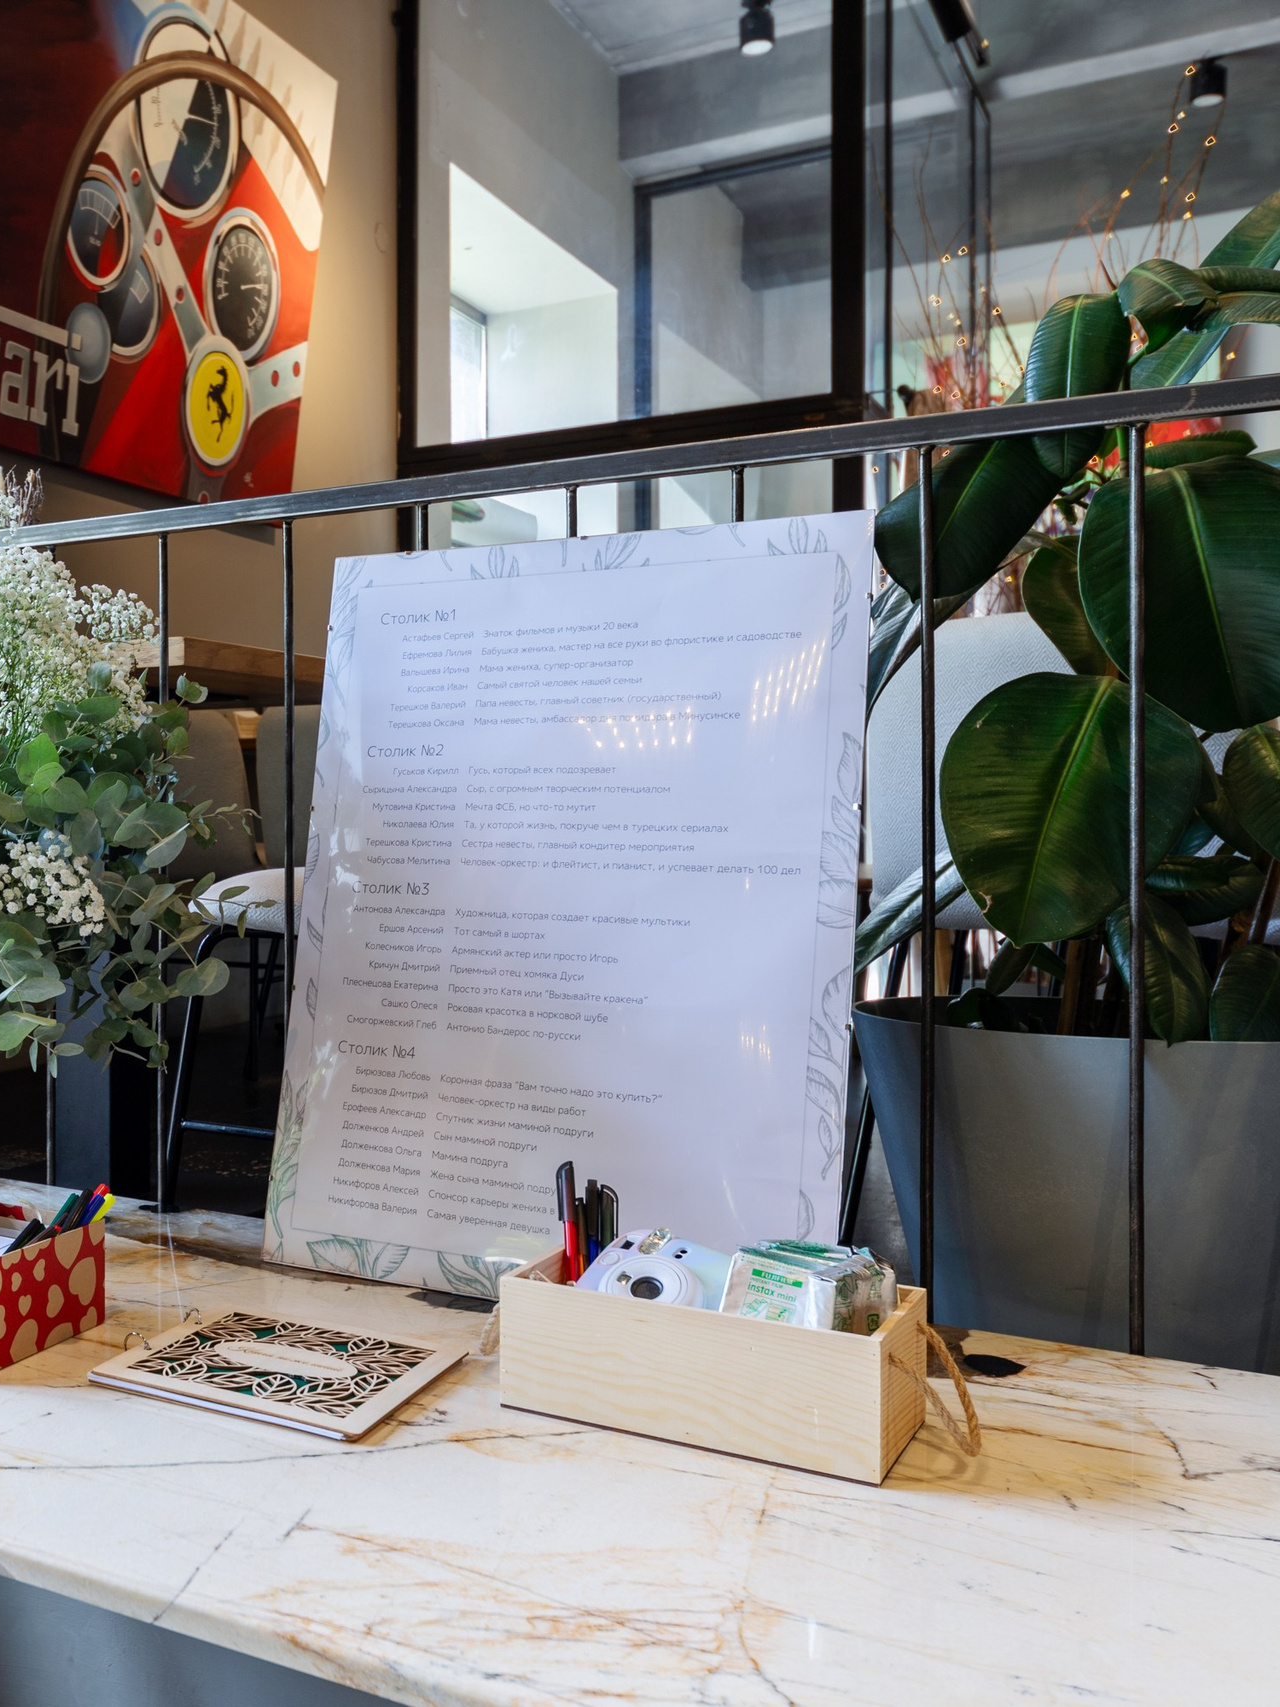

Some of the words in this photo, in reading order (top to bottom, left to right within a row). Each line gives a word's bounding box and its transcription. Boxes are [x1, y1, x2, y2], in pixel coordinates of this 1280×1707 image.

[381, 613, 430, 625] Столик
[435, 609, 455, 622] №1
[402, 634, 441, 642] Астафьев
[443, 631, 474, 641] Сергей
[402, 651, 443, 660] Ефремова
[444, 649, 472, 657] Лилия
[481, 647, 518, 656] Бабушка
[559, 643, 591, 651] мастер
[626, 640, 648, 649] руки
[664, 636, 724, 647] флористике
[736, 631, 802, 641] садоводстве
[401, 668, 441, 677] Валышева
[443, 666, 469, 675] Ирина
[407, 685, 445, 694] Корсаков
[447, 683, 468, 691] Иван
[391, 704, 429, 712] Терешков
[431, 701, 466, 710] Валерий
[389, 721, 431, 729] Терешкова
[433, 719, 464, 727] Оксана
[367, 746, 416, 757] Столик
[421, 744, 444, 756] №2
[393, 768, 425, 777] Гуськов
[427, 767, 459, 776] Кирилл
[362, 786, 404, 794] Сырицына
[407, 785, 457, 794] Александра
[467, 784, 486, 794] Сыр,
[496, 786, 543, 794] огромным
[372, 803, 413, 812] Мутовина
[415, 803, 455, 812] Кристина
[430, 820, 454, 828] Юлия
[366, 838, 409, 847] Терешкова
[411, 839, 452, 848] Кристина
[462, 839, 493, 849] Сестра
[495, 841, 534, 849] невесты,
[538, 841, 577, 849] главный
[580, 843, 626, 852] кондитер
[628, 844, 694, 852] мероприятия
[367, 856, 405, 866] Чабусова
[407, 857, 450, 865] Мелитина
[352, 881, 402, 894] Столик
[407, 882, 429, 895] №3
[353, 905, 392, 914] Антонова
[395, 906, 445, 916] Александра
[455, 908, 509, 919] Художница,
[512, 913, 549, 921] которая
[551, 914, 589, 922] создает
[592, 916, 638, 924] красивые
[641, 918, 690, 927] мультики
[379, 924, 405, 933] Ершов
[407, 925, 443, 934] Арсений
[365, 942, 414, 952] Колесников
[416, 944, 442, 954] Игорь
[451, 946, 501, 956] Армянский
[504, 951, 530, 960] актер
[553, 953, 587, 962] просто
[589, 954, 618, 964] Игорь
[369, 960, 399, 971] Кричун
[401, 962, 440, 973] Дмитрий
[450, 965, 497, 975] Приемный
[499, 970, 521, 978] отец
[524, 971, 557, 979] хомяка
[560, 971, 584, 982] Дуси
[343, 977, 391, 988] Плеснецова
[394, 980, 438, 991] Екатерина
[448, 984, 480, 994] Просто
[501, 987, 522, 996] Катя
[381, 998, 408, 1008] Сашко
[410, 1000, 437, 1010] Олеся
[448, 1003, 483, 1013] Роковая
[485, 1008, 526, 1017] красотка
[537, 1012, 581, 1020] норковой
[584, 1013, 608, 1024] шубе
[347, 1015, 414, 1027] Смогоржевский
[416, 1020, 437, 1030] Глеб
[446, 1023, 485, 1033] Антонио
[487, 1025, 530, 1037] Бандерос
[533, 1031, 581, 1041] по-русски
[338, 1040, 388, 1056] Столик
[393, 1045, 415, 1059] №4
[356, 1066, 396, 1078] Бирюзова
[398, 1070, 430, 1081] Любовь
[440, 1074, 482, 1085] Коронная
[485, 1079, 512, 1089] фраза
[540, 1085, 568, 1095] точно
[570, 1088, 594, 1097] надо
[597, 1091, 613, 1099] это
[351, 1084, 387, 1095] Бирюзов
[389, 1088, 428, 1100] Дмитрий
[343, 1102, 377, 1113] Ерофеев
[379, 1106, 426, 1120] Александр
[436, 1112, 474, 1124] Спутник
[477, 1119, 505, 1128] жизни
[508, 1122, 550, 1133] маминой
[553, 1127, 593, 1139] подруги
[342, 1120, 389, 1134] Долженков
[391, 1127, 424, 1138] Андрей
[434, 1131, 452, 1141] Сын
[455, 1136, 495, 1146] маминой
[498, 1141, 537, 1152] подруги
[341, 1139, 393, 1153] Долженкова
[395, 1146, 422, 1157] Ольга
[432, 1151, 467, 1163] Мамина
[470, 1157, 508, 1169] подруга
[333, 1176, 380, 1191] Никифоров
[382, 1183, 419, 1195] Алексей
[338, 1158, 390, 1173] Долженкова
[393, 1165, 420, 1176] Мария
[430, 1170, 454, 1181] Жена
[457, 1175, 479, 1184] сына
[482, 1179, 524, 1190] маминой
[527, 1184, 556, 1198] подру
[328, 1195, 379, 1210] Никифорова
[382, 1202, 417, 1215] Валерия
[427, 1209, 456, 1221] Самая
[459, 1216, 507, 1228] уверенная
[510, 1223, 550, 1235] девушка
[747, 1283, 775, 1296] instax
[777, 1293, 796, 1302] mini
